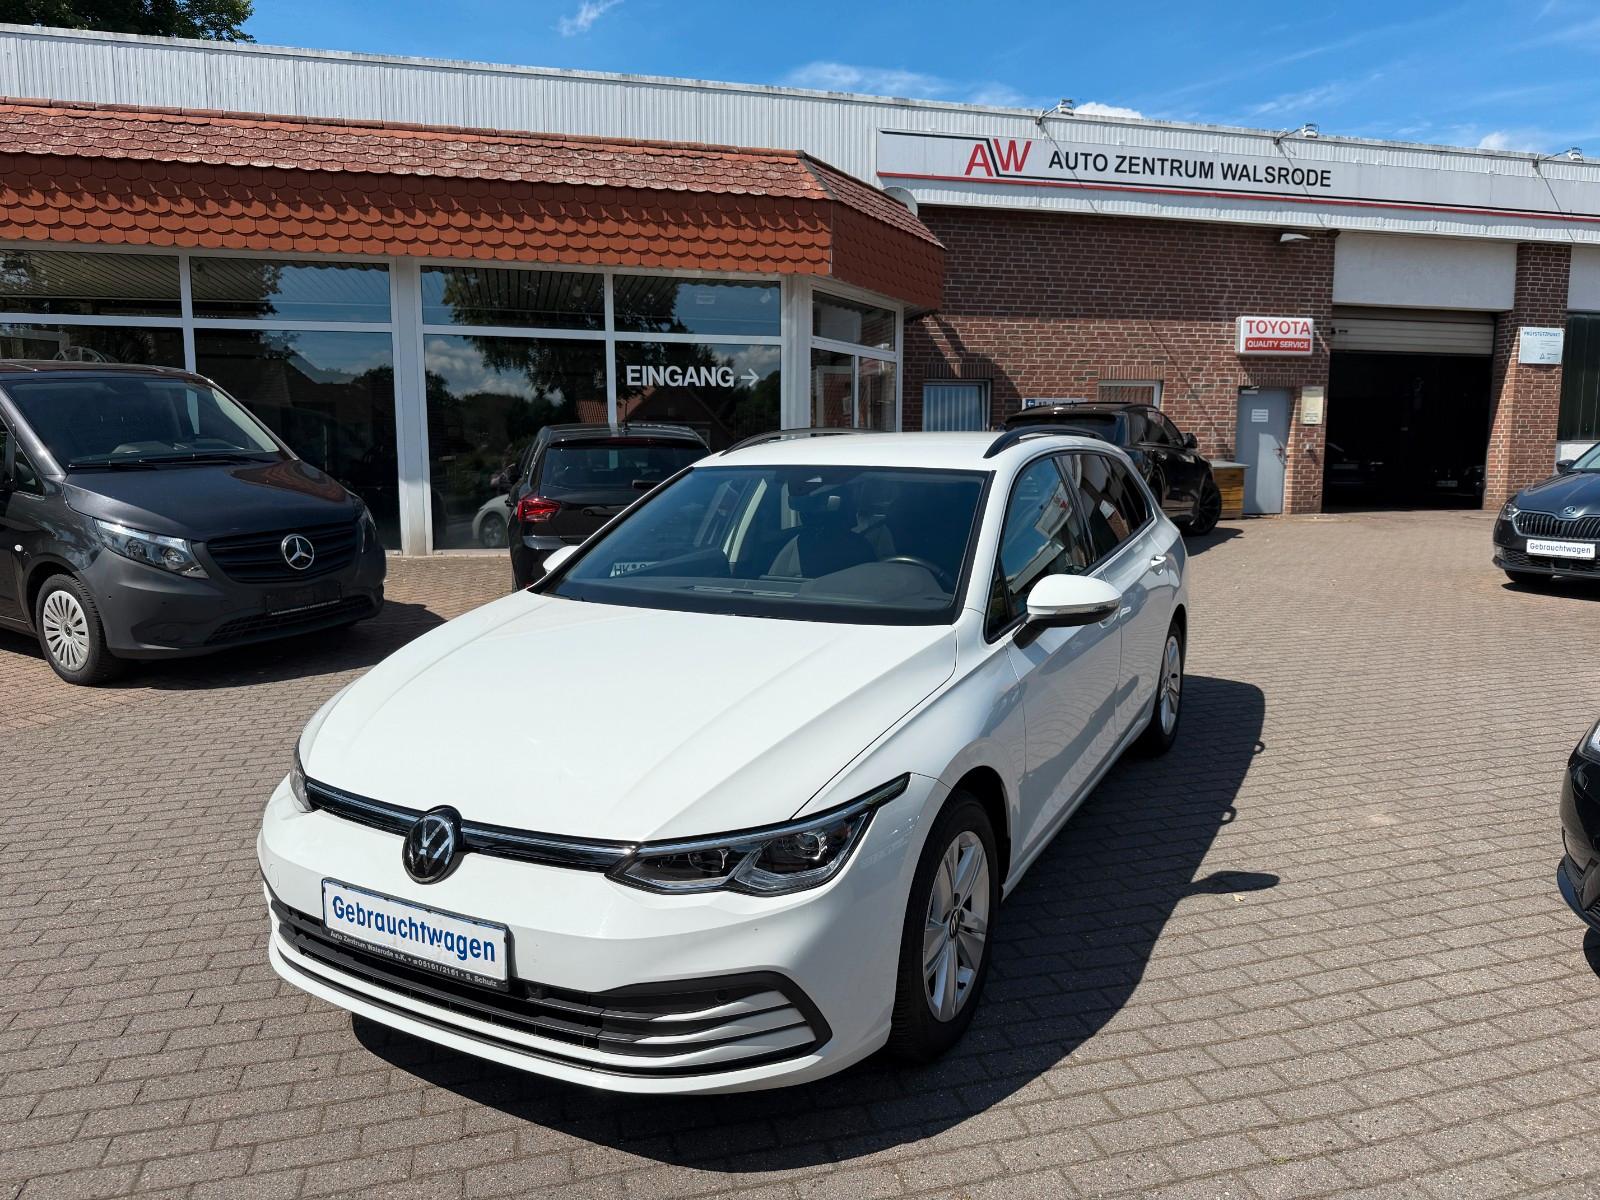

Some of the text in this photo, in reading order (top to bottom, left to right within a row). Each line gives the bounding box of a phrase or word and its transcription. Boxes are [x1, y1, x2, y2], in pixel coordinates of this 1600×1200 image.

[1048, 150, 1332, 188] AUTO ZENTRUM WALSRODE
[1246, 320, 1311, 335] TOYOTA
[1247, 340, 1309, 349] QUALITY SERVICE
[626, 365, 735, 388] EINGANG
[1529, 542, 1591, 555] Gebrauchtwagen
[332, 895, 496, 963] Gebrauchtwagen
[330, 930, 343, 941] Auto
[343, 935, 367, 949] Zentrum
[366, 943, 394, 958] Walsrode
[465, 973, 473, 981] S.
[474, 976, 498, 987] Schulz
